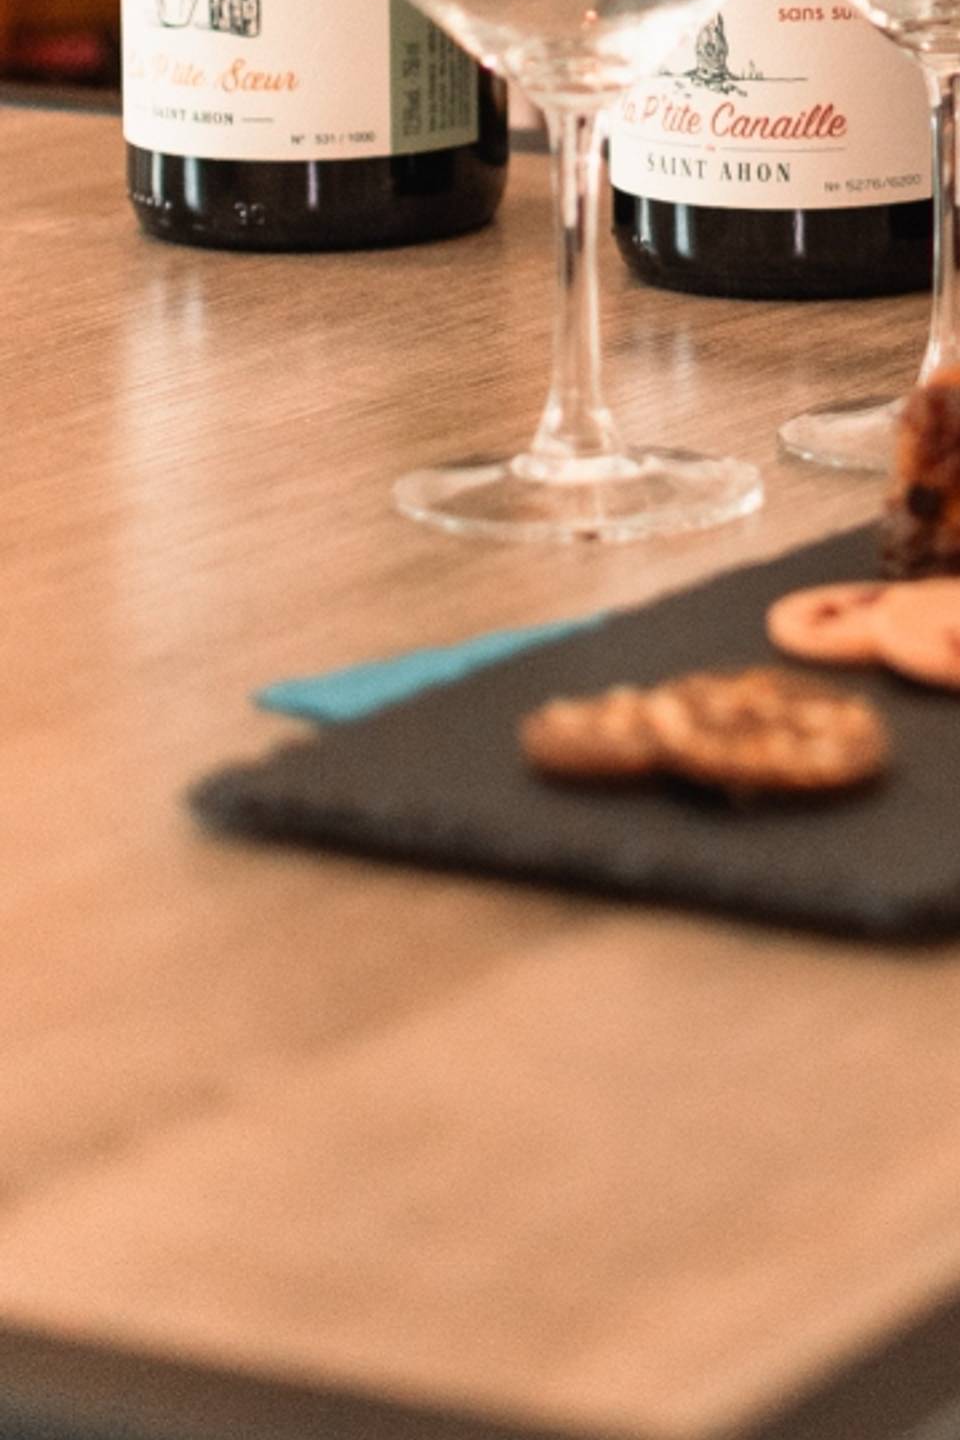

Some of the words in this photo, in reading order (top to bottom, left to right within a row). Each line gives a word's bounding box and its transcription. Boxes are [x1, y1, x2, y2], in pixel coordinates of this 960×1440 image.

[778, 6, 824, 22] sans
[192, 110, 236, 127] AHON
[709, 100, 848, 141] Canaille
[646, 151, 708, 182] SAINT
[719, 160, 792, 183] AHON
